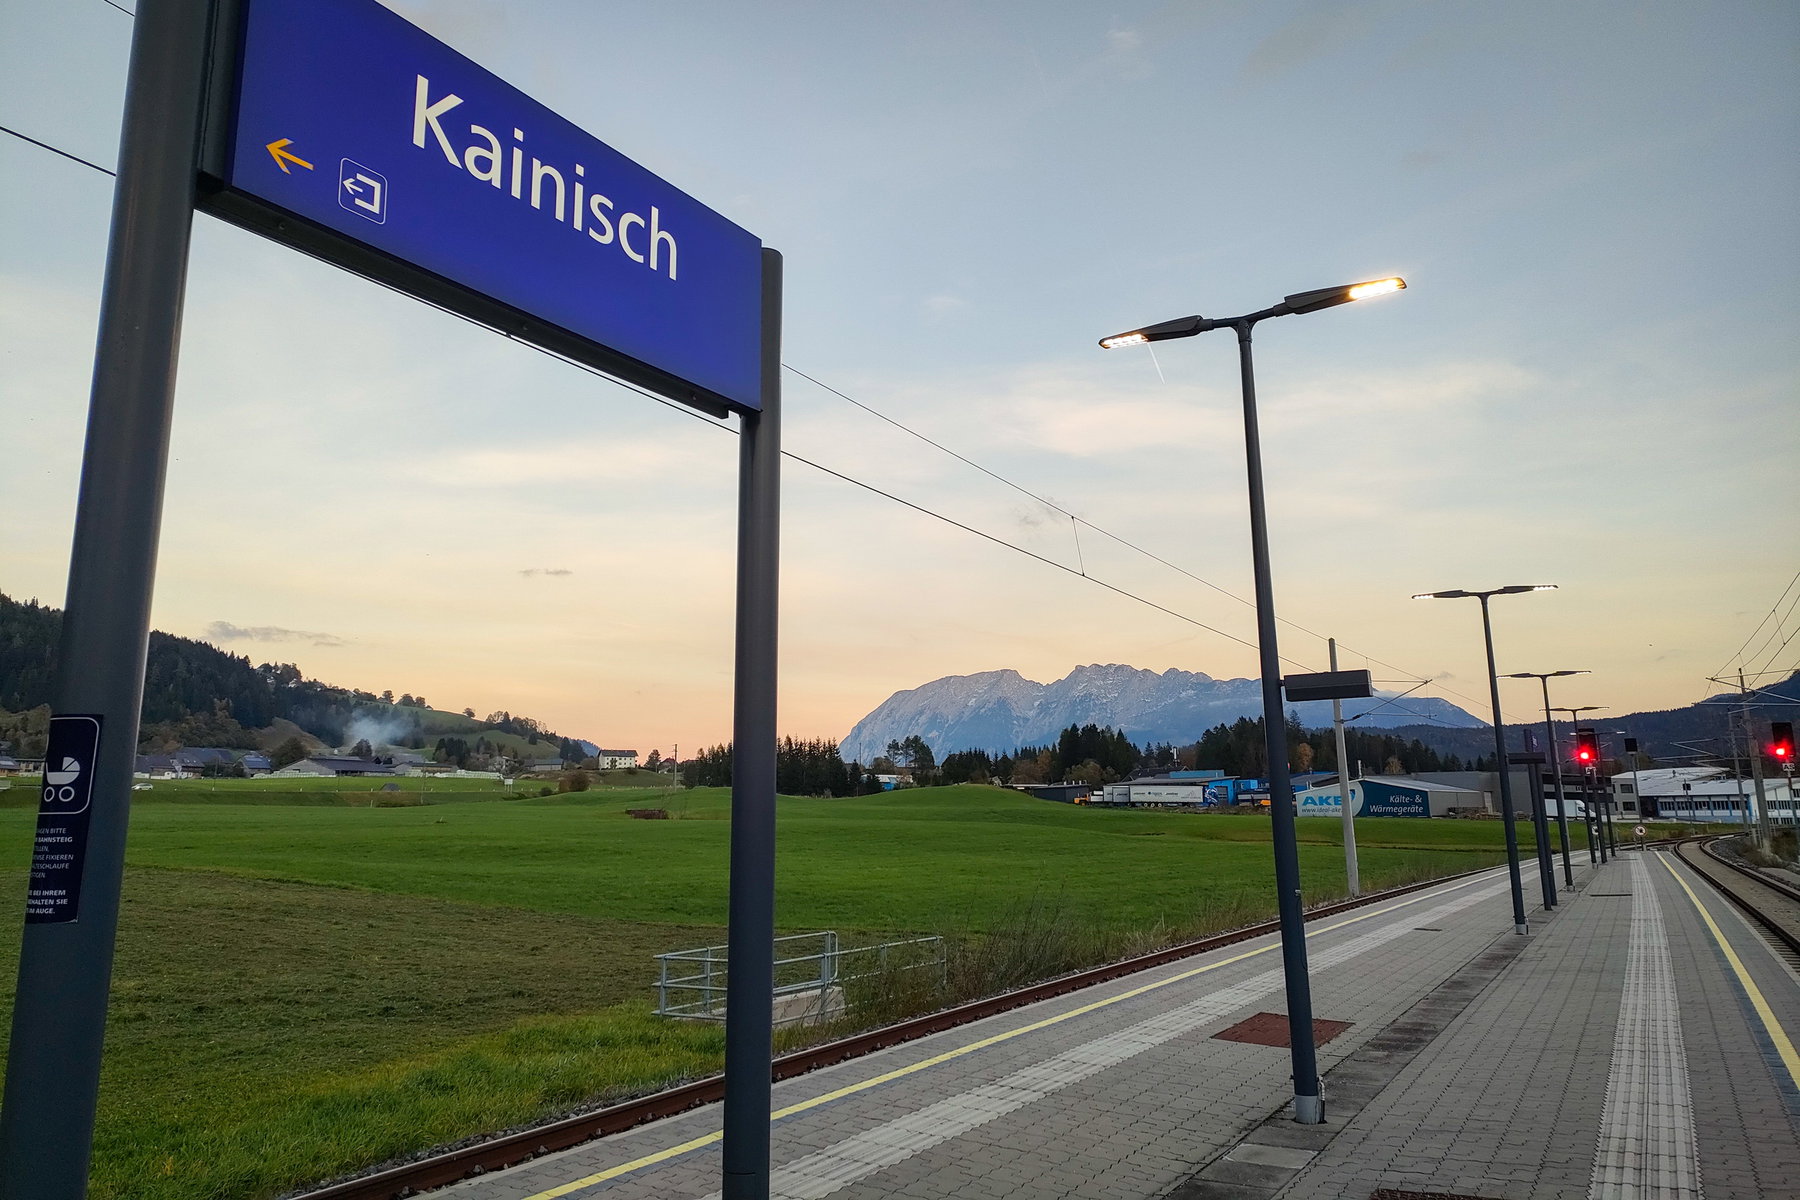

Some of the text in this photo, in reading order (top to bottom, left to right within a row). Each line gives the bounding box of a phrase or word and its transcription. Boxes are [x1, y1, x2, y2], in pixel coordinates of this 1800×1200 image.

[413, 74, 678, 281] Kainisch
[1302, 796, 1342, 806] AKE
[1390, 795, 1422, 803] Kälte- &
[1369, 805, 1424, 815] Wärmegeräte
